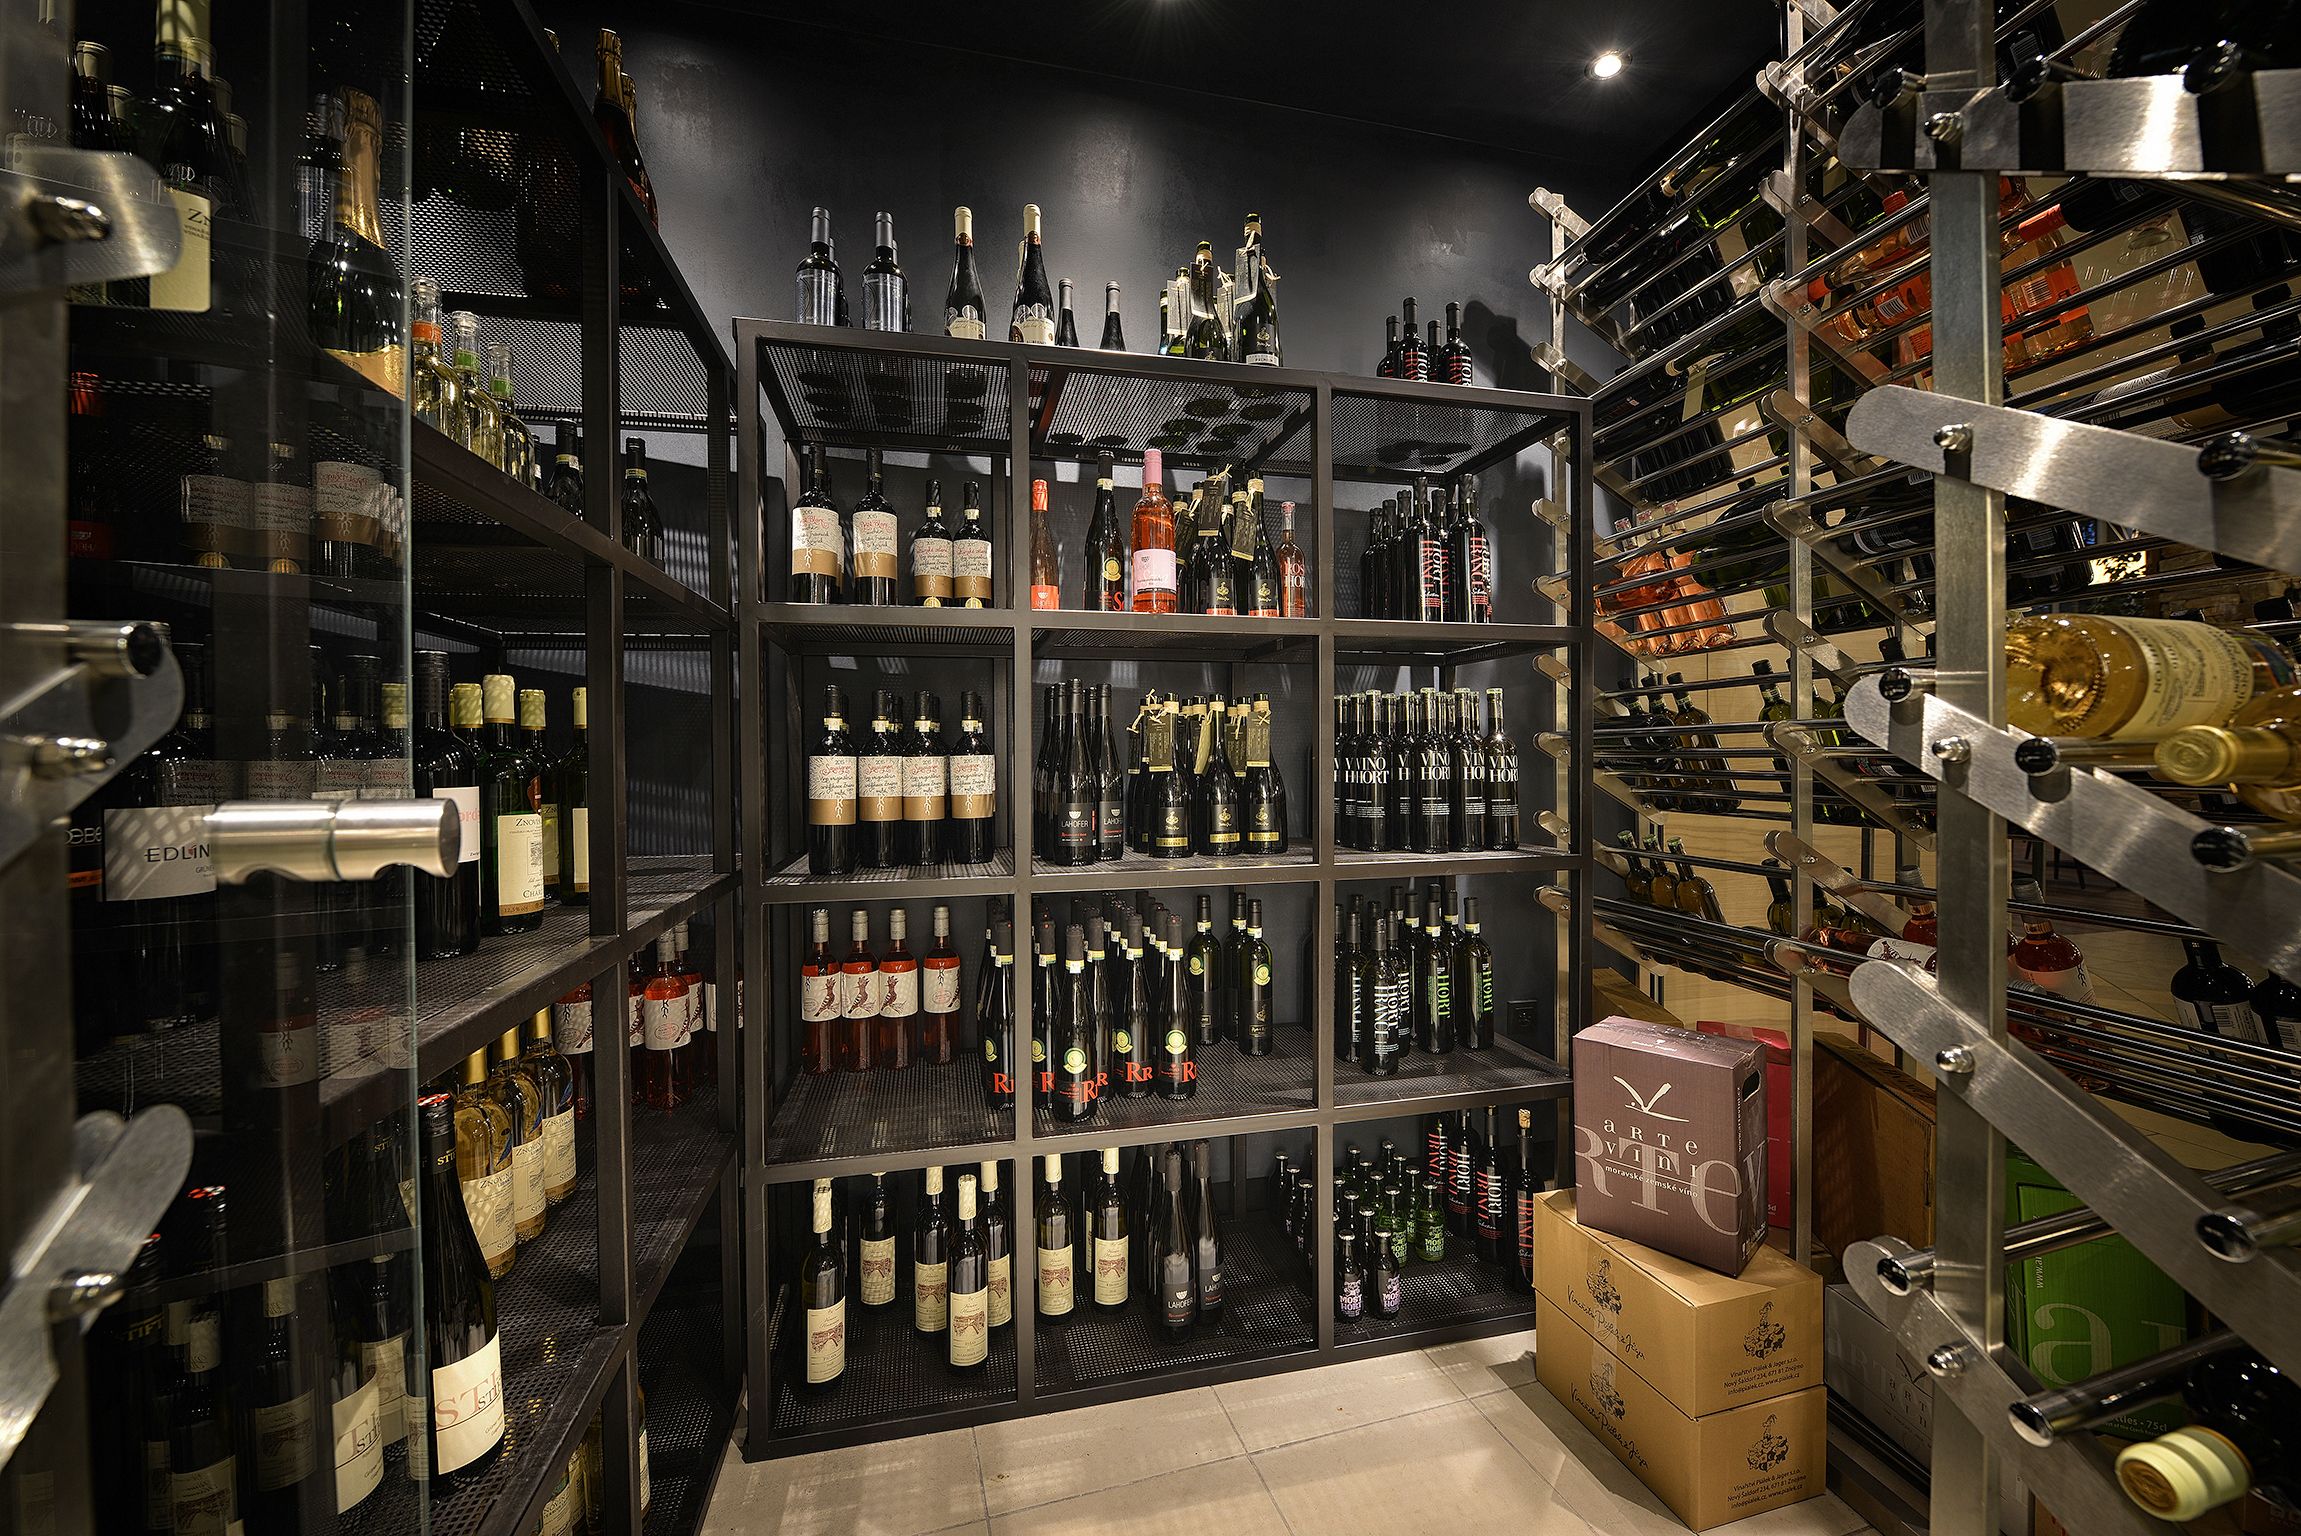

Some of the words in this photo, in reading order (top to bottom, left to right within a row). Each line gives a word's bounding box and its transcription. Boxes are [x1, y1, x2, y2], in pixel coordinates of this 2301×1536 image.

[1061, 820, 1089, 828] LAHOFER
[1605, 1165, 1644, 1182] moravské
[1645, 1178, 1677, 1192] zemské
[1678, 1185, 1698, 1198] víno
